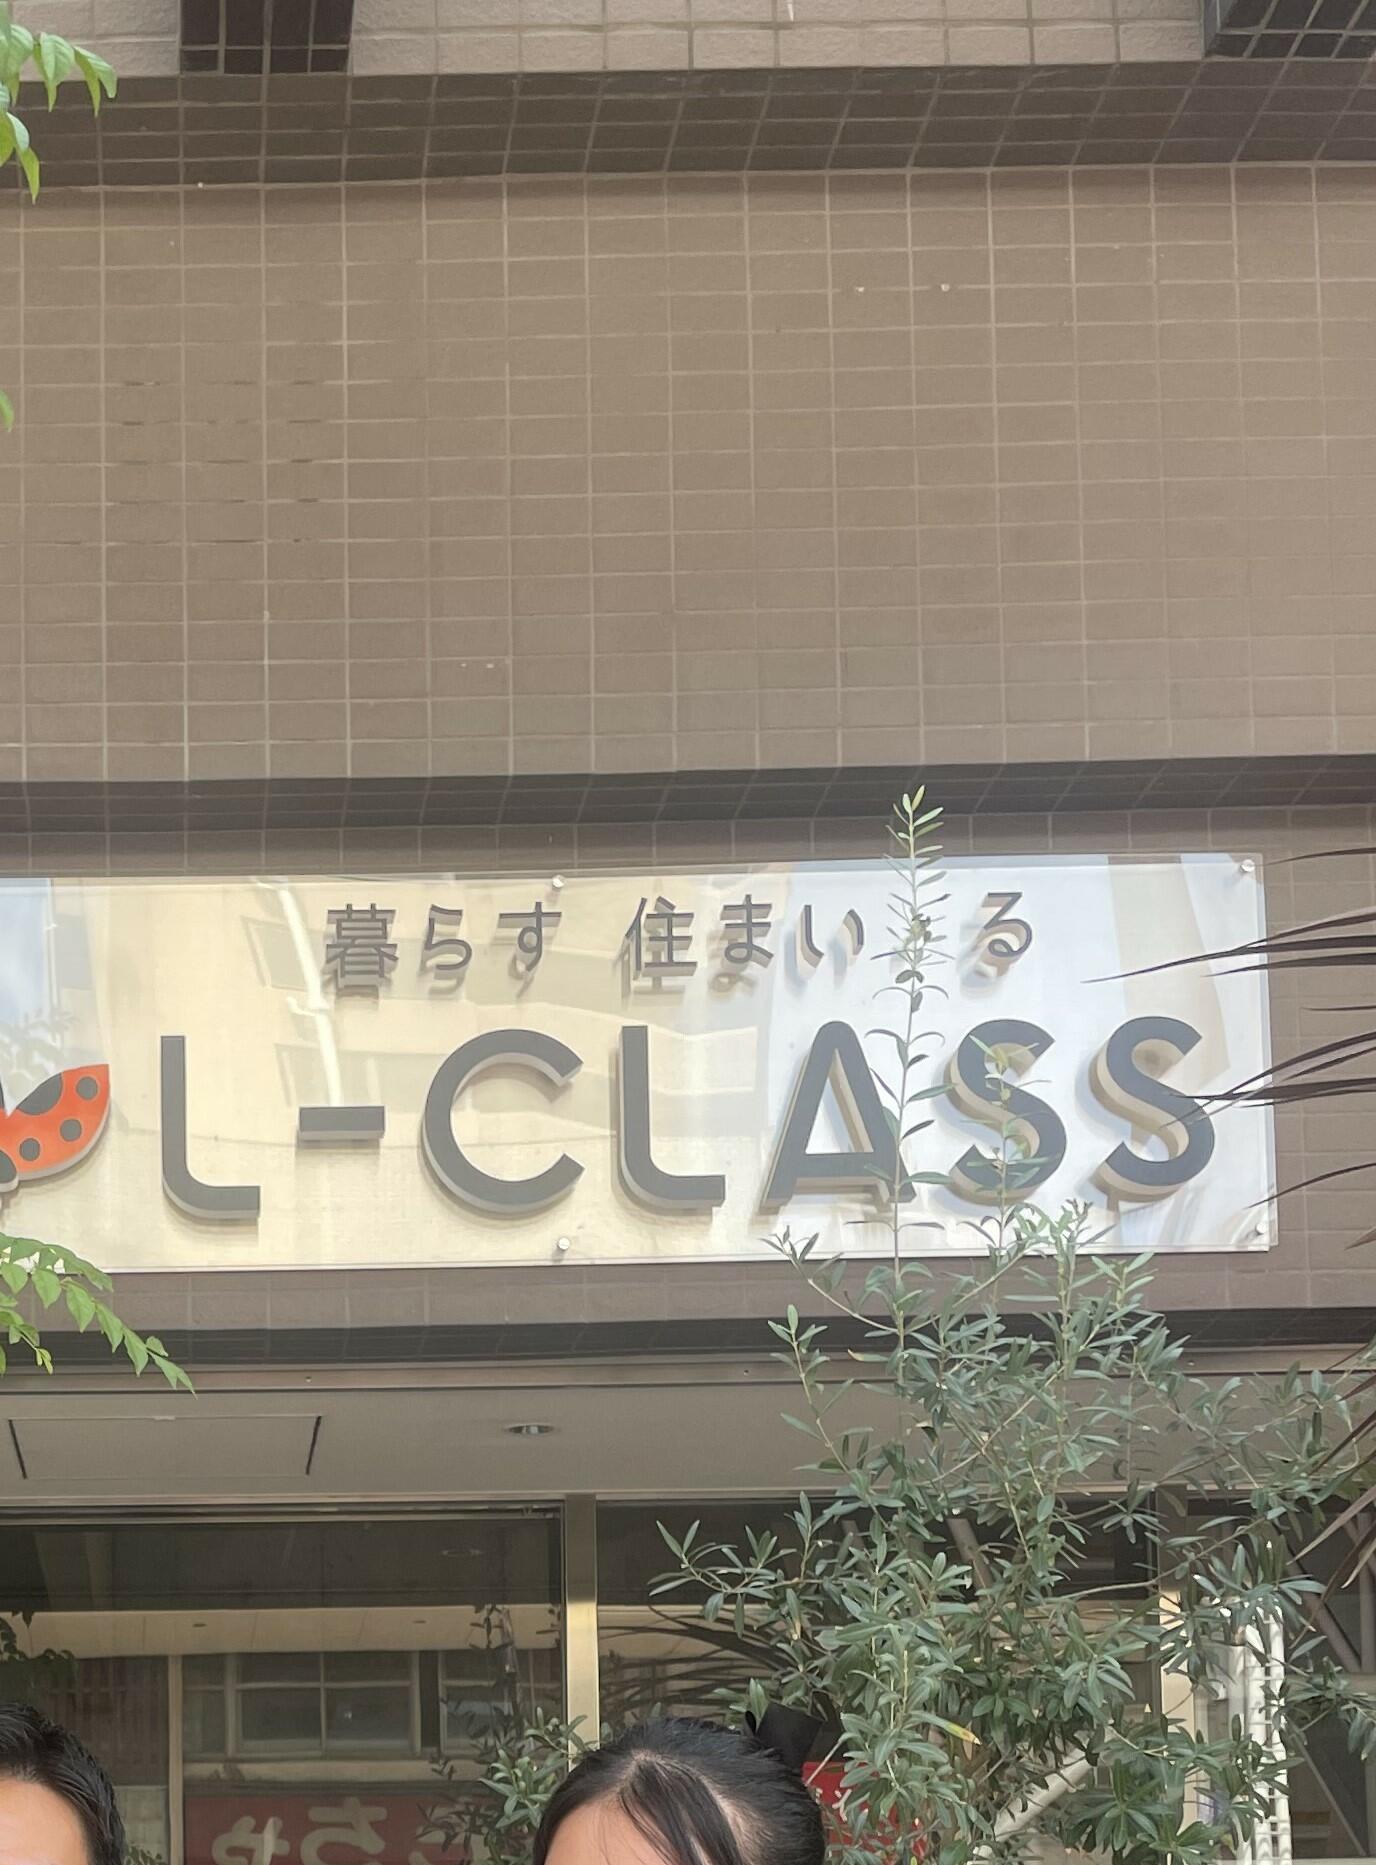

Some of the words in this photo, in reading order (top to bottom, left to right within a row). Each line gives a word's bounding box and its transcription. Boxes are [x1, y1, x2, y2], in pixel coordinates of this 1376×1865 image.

[325, 901, 562, 977] 暮らす
[161, 1016, 1216, 1216] L-CLASS
